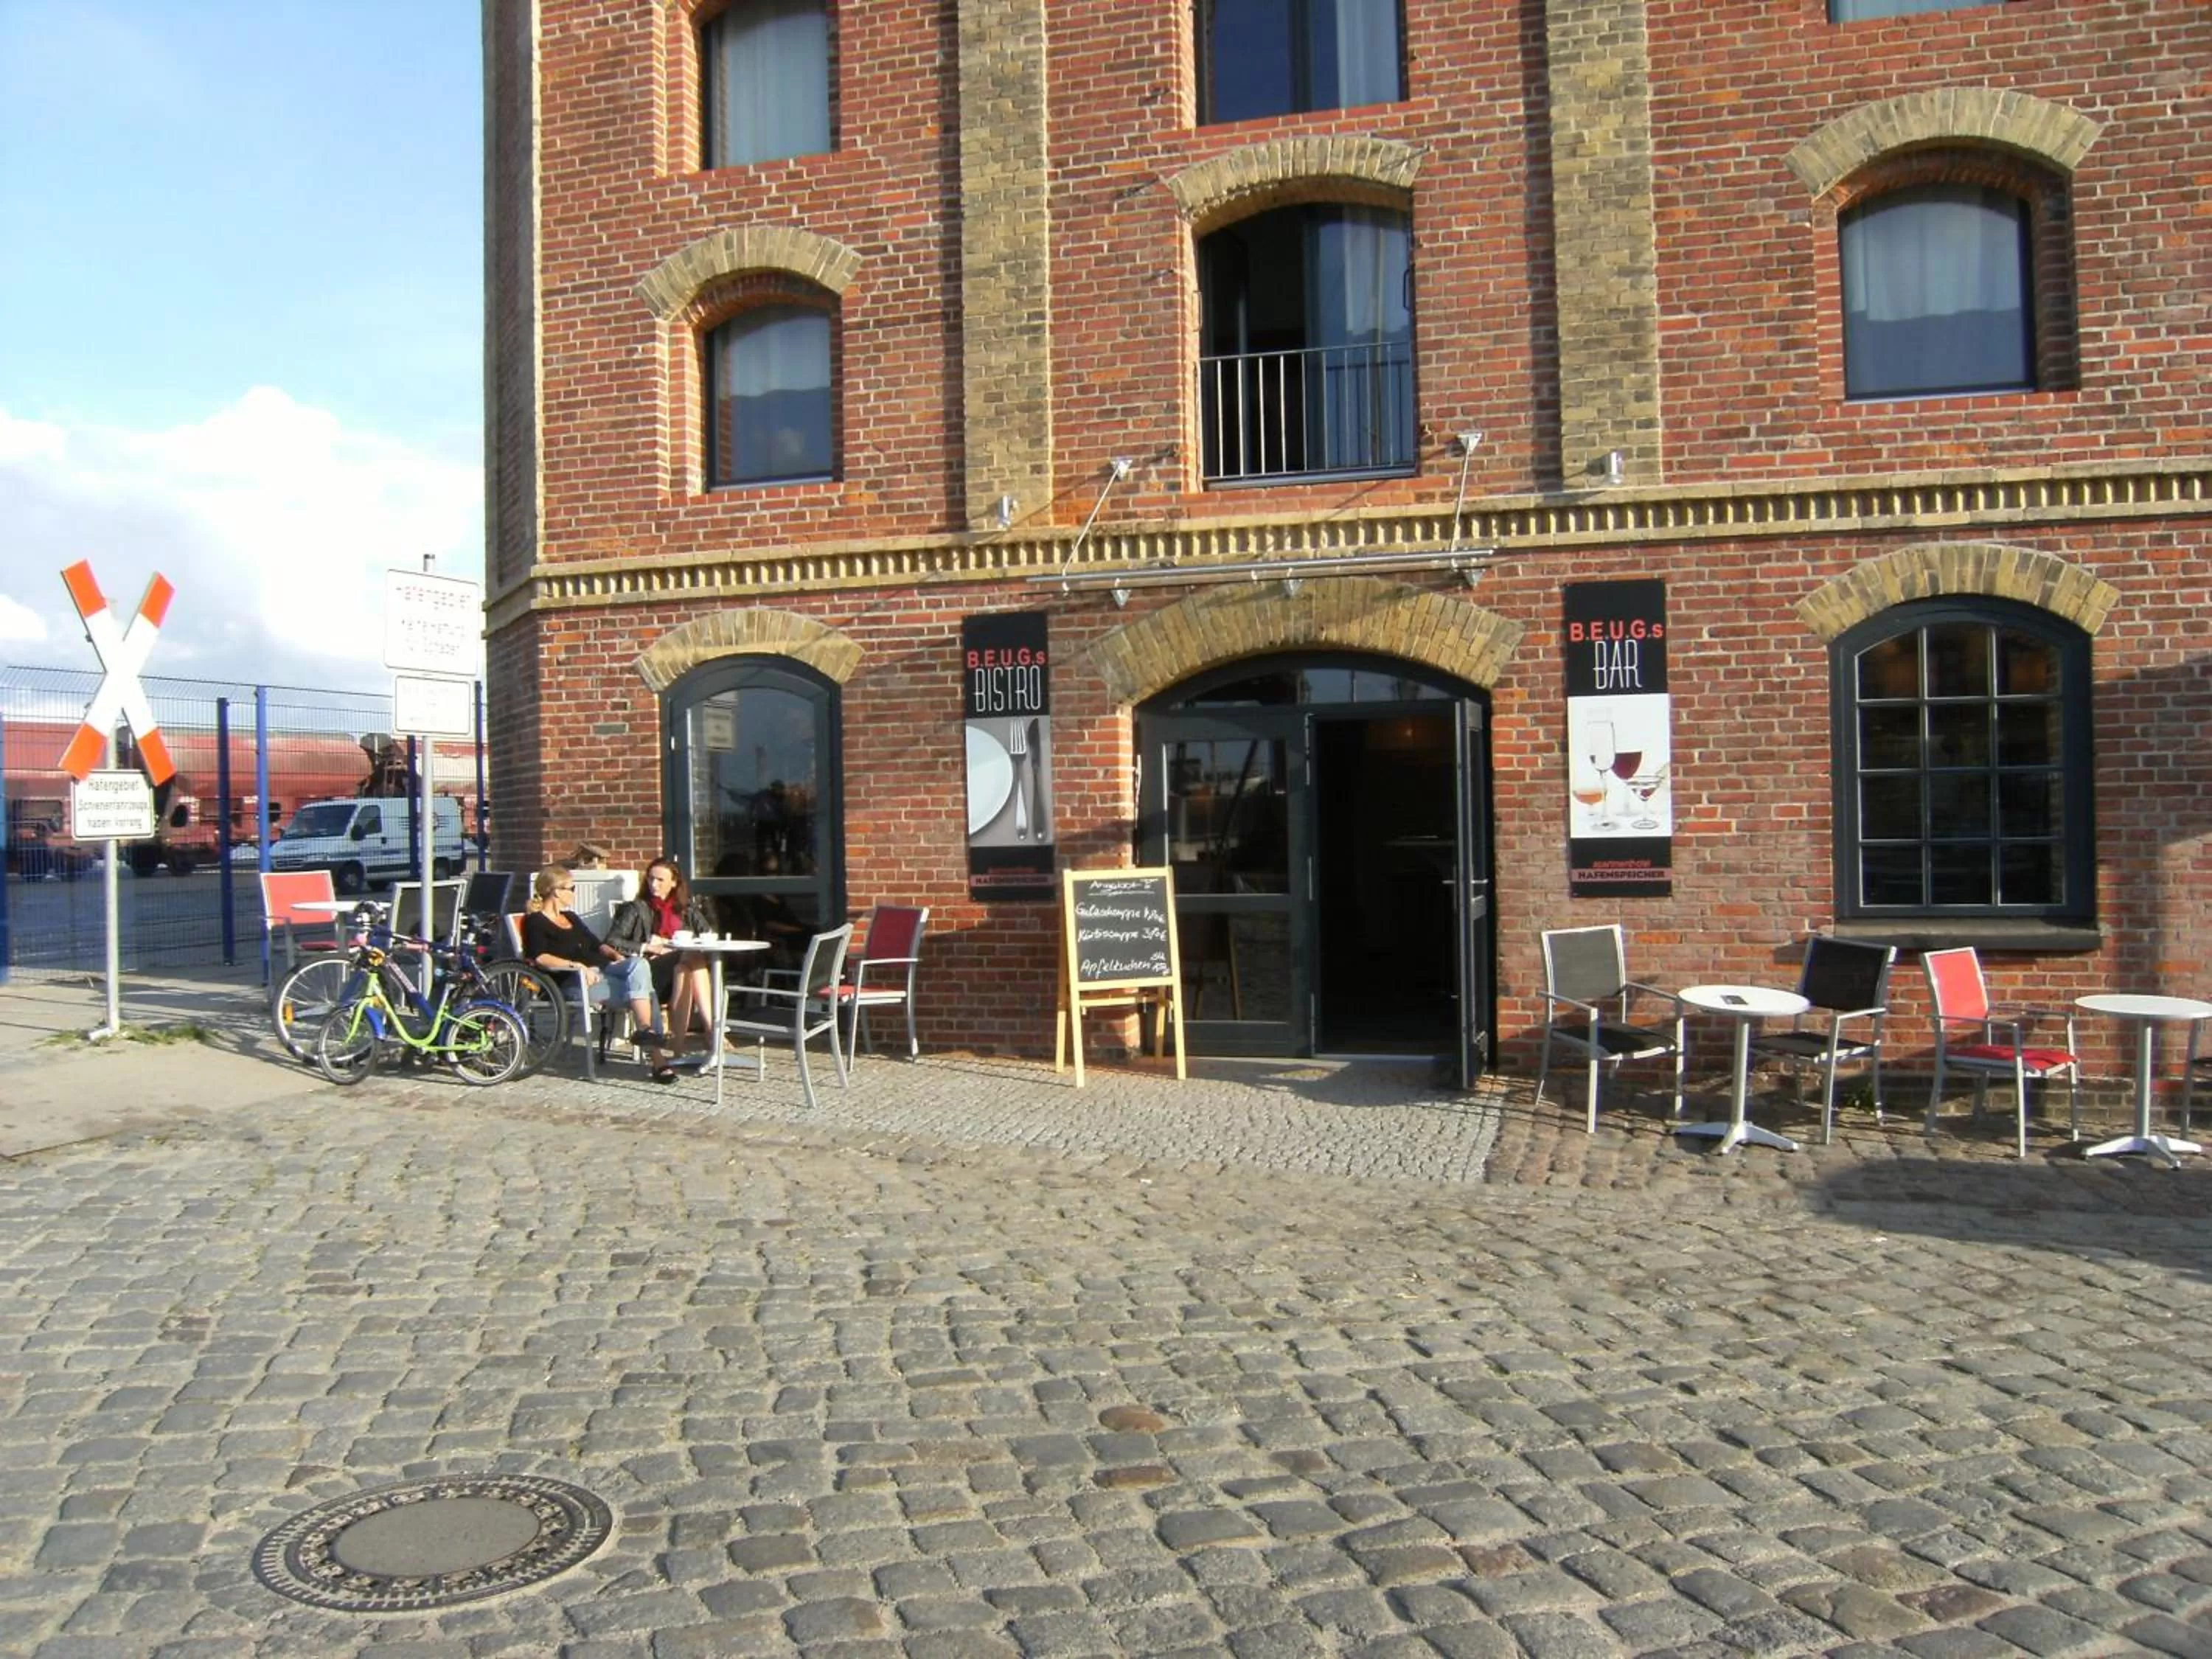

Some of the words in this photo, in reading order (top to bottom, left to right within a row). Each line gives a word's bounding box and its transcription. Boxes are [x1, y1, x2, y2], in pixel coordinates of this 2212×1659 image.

[1593, 639, 1643, 689] BAR
[973, 665, 1041, 712] BISTRO
[1577, 870, 1666, 880] HAFENSPEICHER
[1081, 957, 1150, 979] Apfelkuchen
